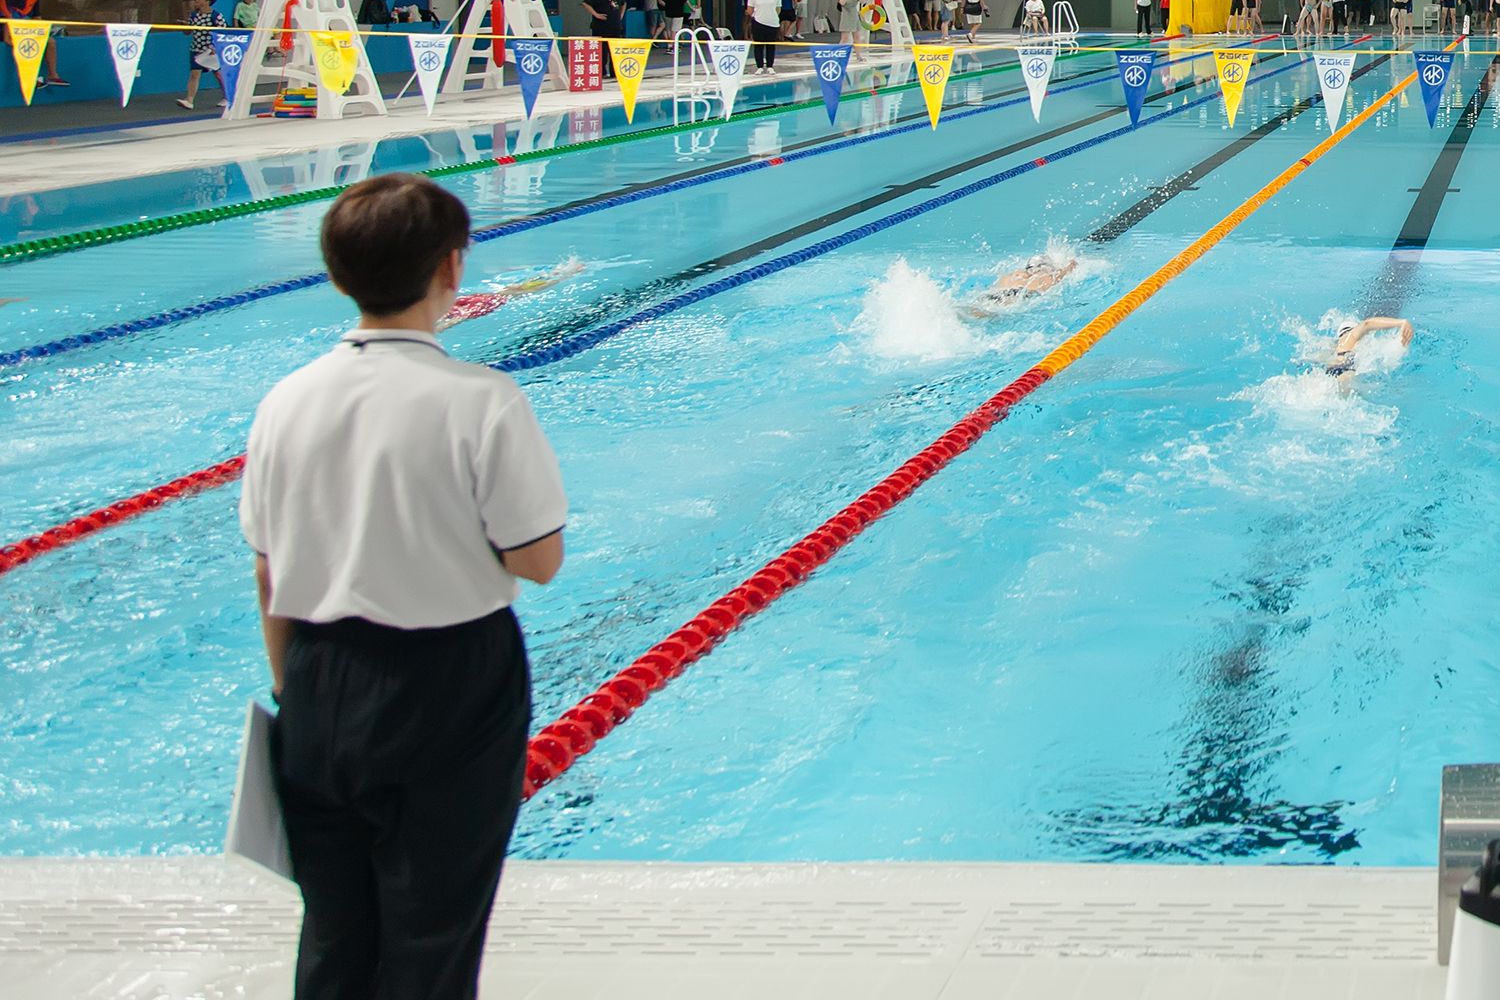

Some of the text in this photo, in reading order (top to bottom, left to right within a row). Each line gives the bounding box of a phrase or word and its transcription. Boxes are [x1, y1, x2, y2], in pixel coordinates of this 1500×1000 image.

[14, 28, 45, 36] ZOKE
[112, 29, 144, 37] ZOKE
[217, 34, 249, 43] ZOKE
[414, 40, 446, 48] ZOKE
[516, 43, 549, 52] ZOKE
[614, 47, 645, 55] ZOKE
[713, 45, 745, 53] ZOKE
[1021, 48, 1053, 56] ZOKE
[815, 50, 847, 58] ZOKE
[919, 54, 950, 62] ZOKE
[1218, 52, 1249, 61] ZOKE
[1120, 55, 1152, 64] ZOKE
[1319, 58, 1350, 66] ZOKE
[1418, 54, 1450, 63] ZOKE
[574, 40, 585, 88] 禁止潜水
[589, 40, 599, 87] 禁止嬉闹
